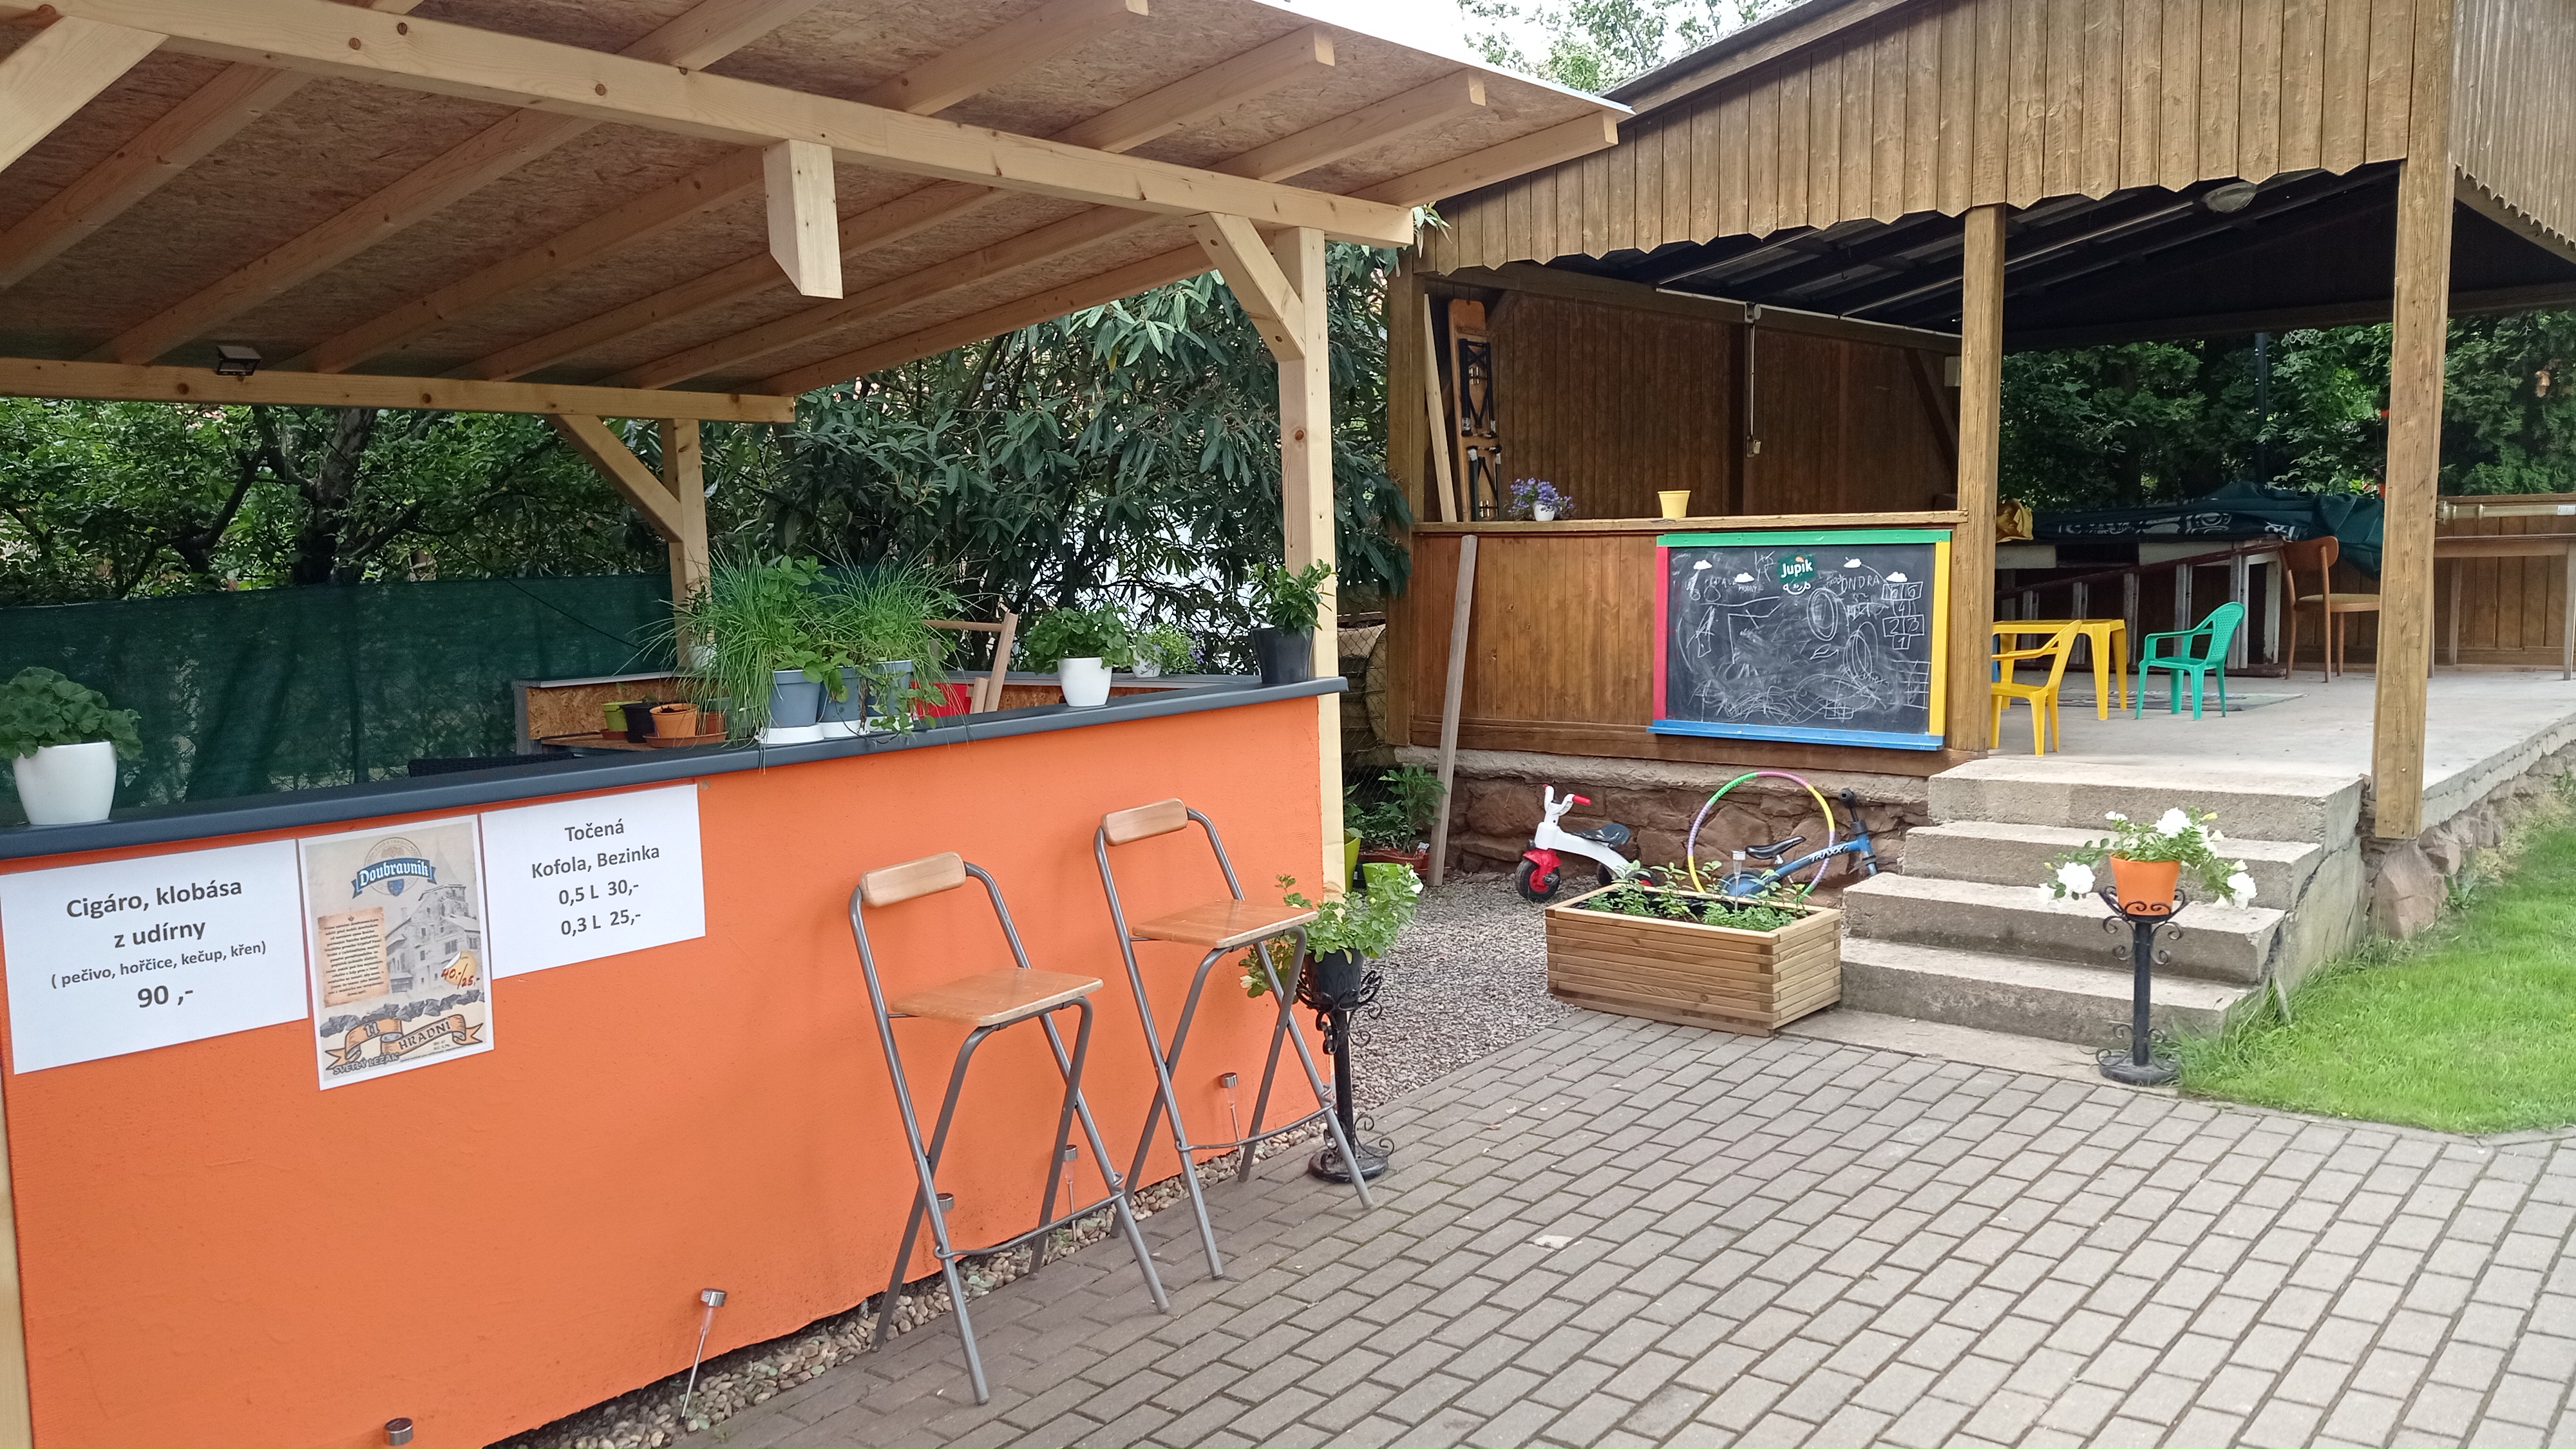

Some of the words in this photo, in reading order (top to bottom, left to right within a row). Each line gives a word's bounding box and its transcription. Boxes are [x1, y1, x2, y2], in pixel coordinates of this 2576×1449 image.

[1889, 618, 1899, 634] 2
[1898, 636, 1905, 648] 1
[564, 818, 624, 842] Točená
[532, 856, 592, 878] Kofola,
[597, 845, 659, 867] Bezinka
[66, 893, 149, 919] Cigáro,
[156, 880, 242, 905] klobása
[559, 887, 585, 907] 0,5
[590, 885, 599, 899] L
[608, 879, 639, 896] 30,-
[114, 934, 126, 949] z
[133, 922, 206, 945] udírny
[561, 917, 587, 937] 0,3
[592, 915, 601, 929] L
[610, 909, 641, 926] 25,-
[61, 969, 116, 988] pečivo,
[120, 958, 177, 975] hořčice,
[181, 950, 227, 965] kečup,
[231, 940, 266, 957] křen)
[137, 985, 169, 1008] 90
[177, 990, 194, 1006] ,-
